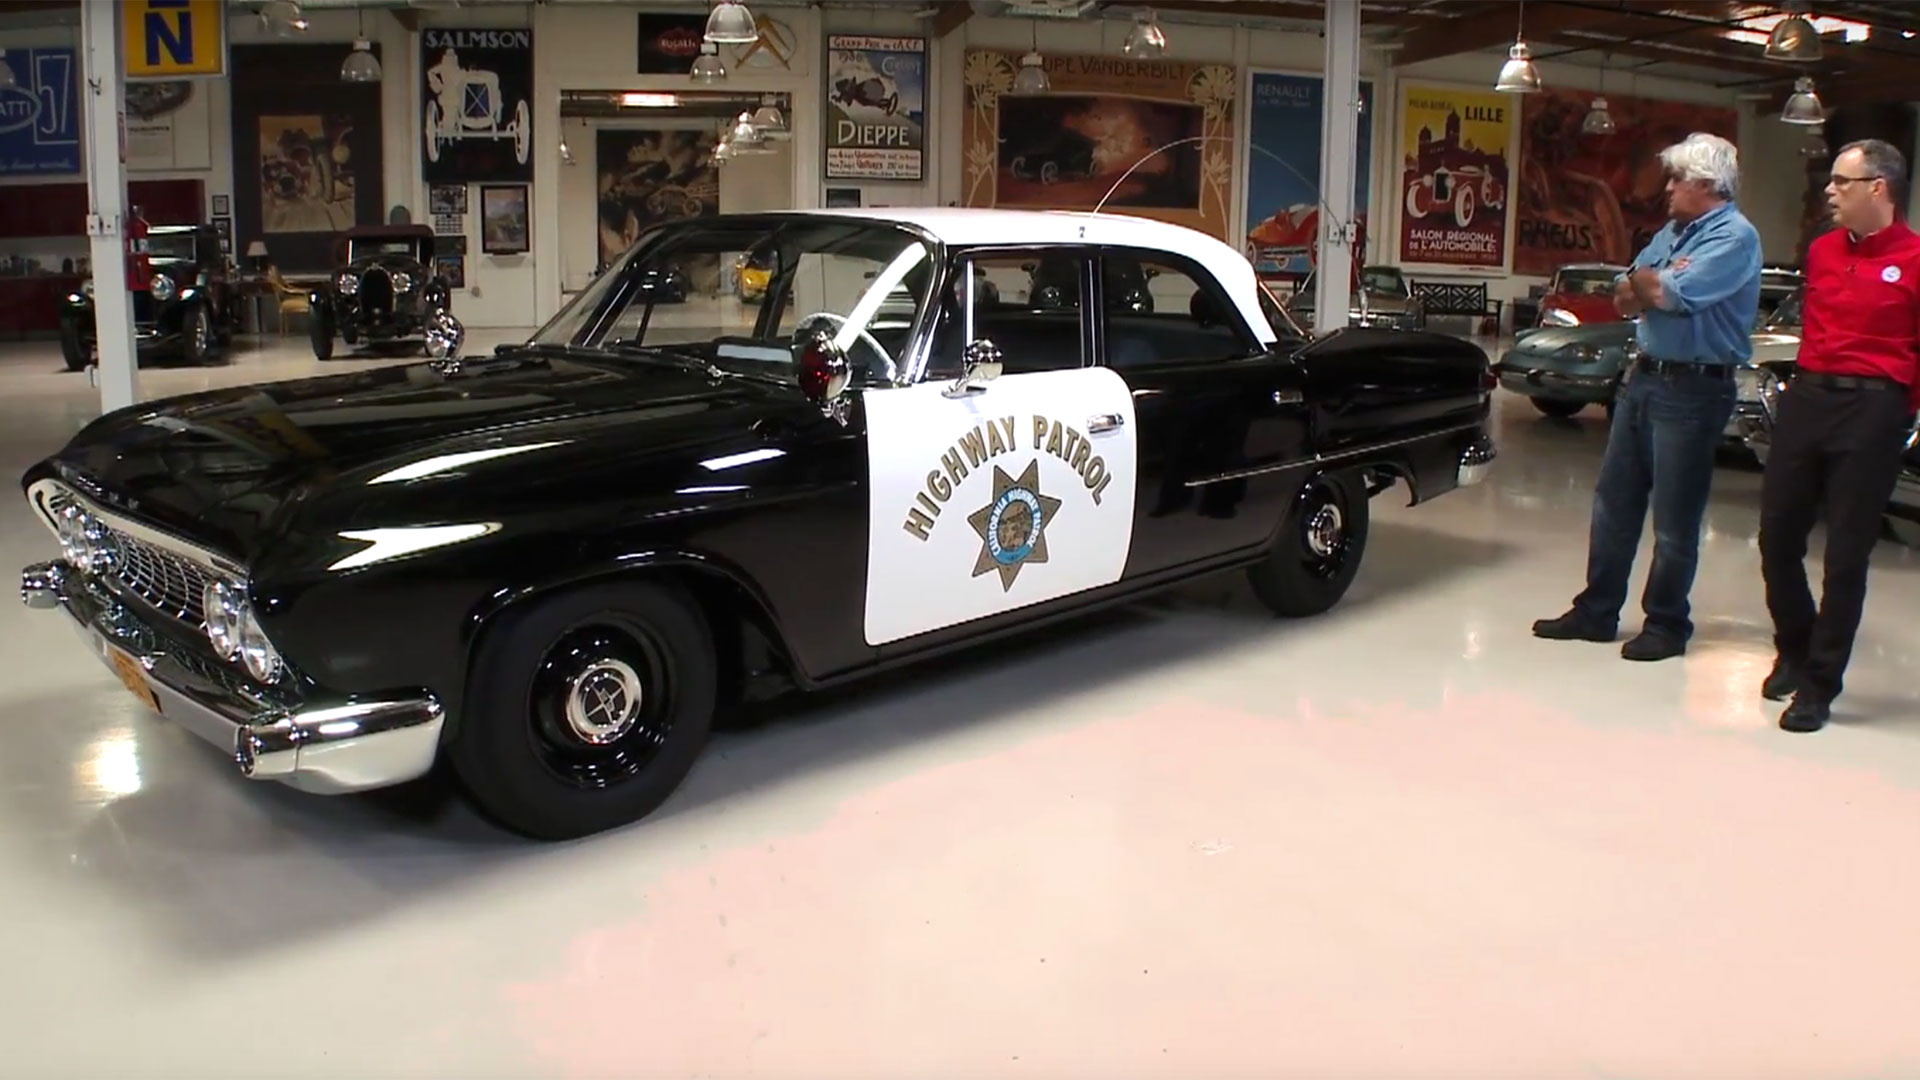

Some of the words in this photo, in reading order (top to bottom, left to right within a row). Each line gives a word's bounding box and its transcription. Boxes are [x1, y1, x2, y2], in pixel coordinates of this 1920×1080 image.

[425, 30, 530, 49] SALMSON
[1080, 55, 1187, 80] VANDERBILT
[1256, 83, 1310, 98] RENAULT
[1465, 105, 1504, 123] LILLE
[838, 119, 910, 146] DIEPPE
[1410, 229, 1443, 240] SALON
[902, 415, 1016, 542] HIGHWAY
[1033, 414, 1112, 507] PATROL
[988, 496, 1009, 556] CALIFORNIA
[1008, 488, 1039, 511] HIGHWAY
[1025, 510, 1042, 548] PATROL
